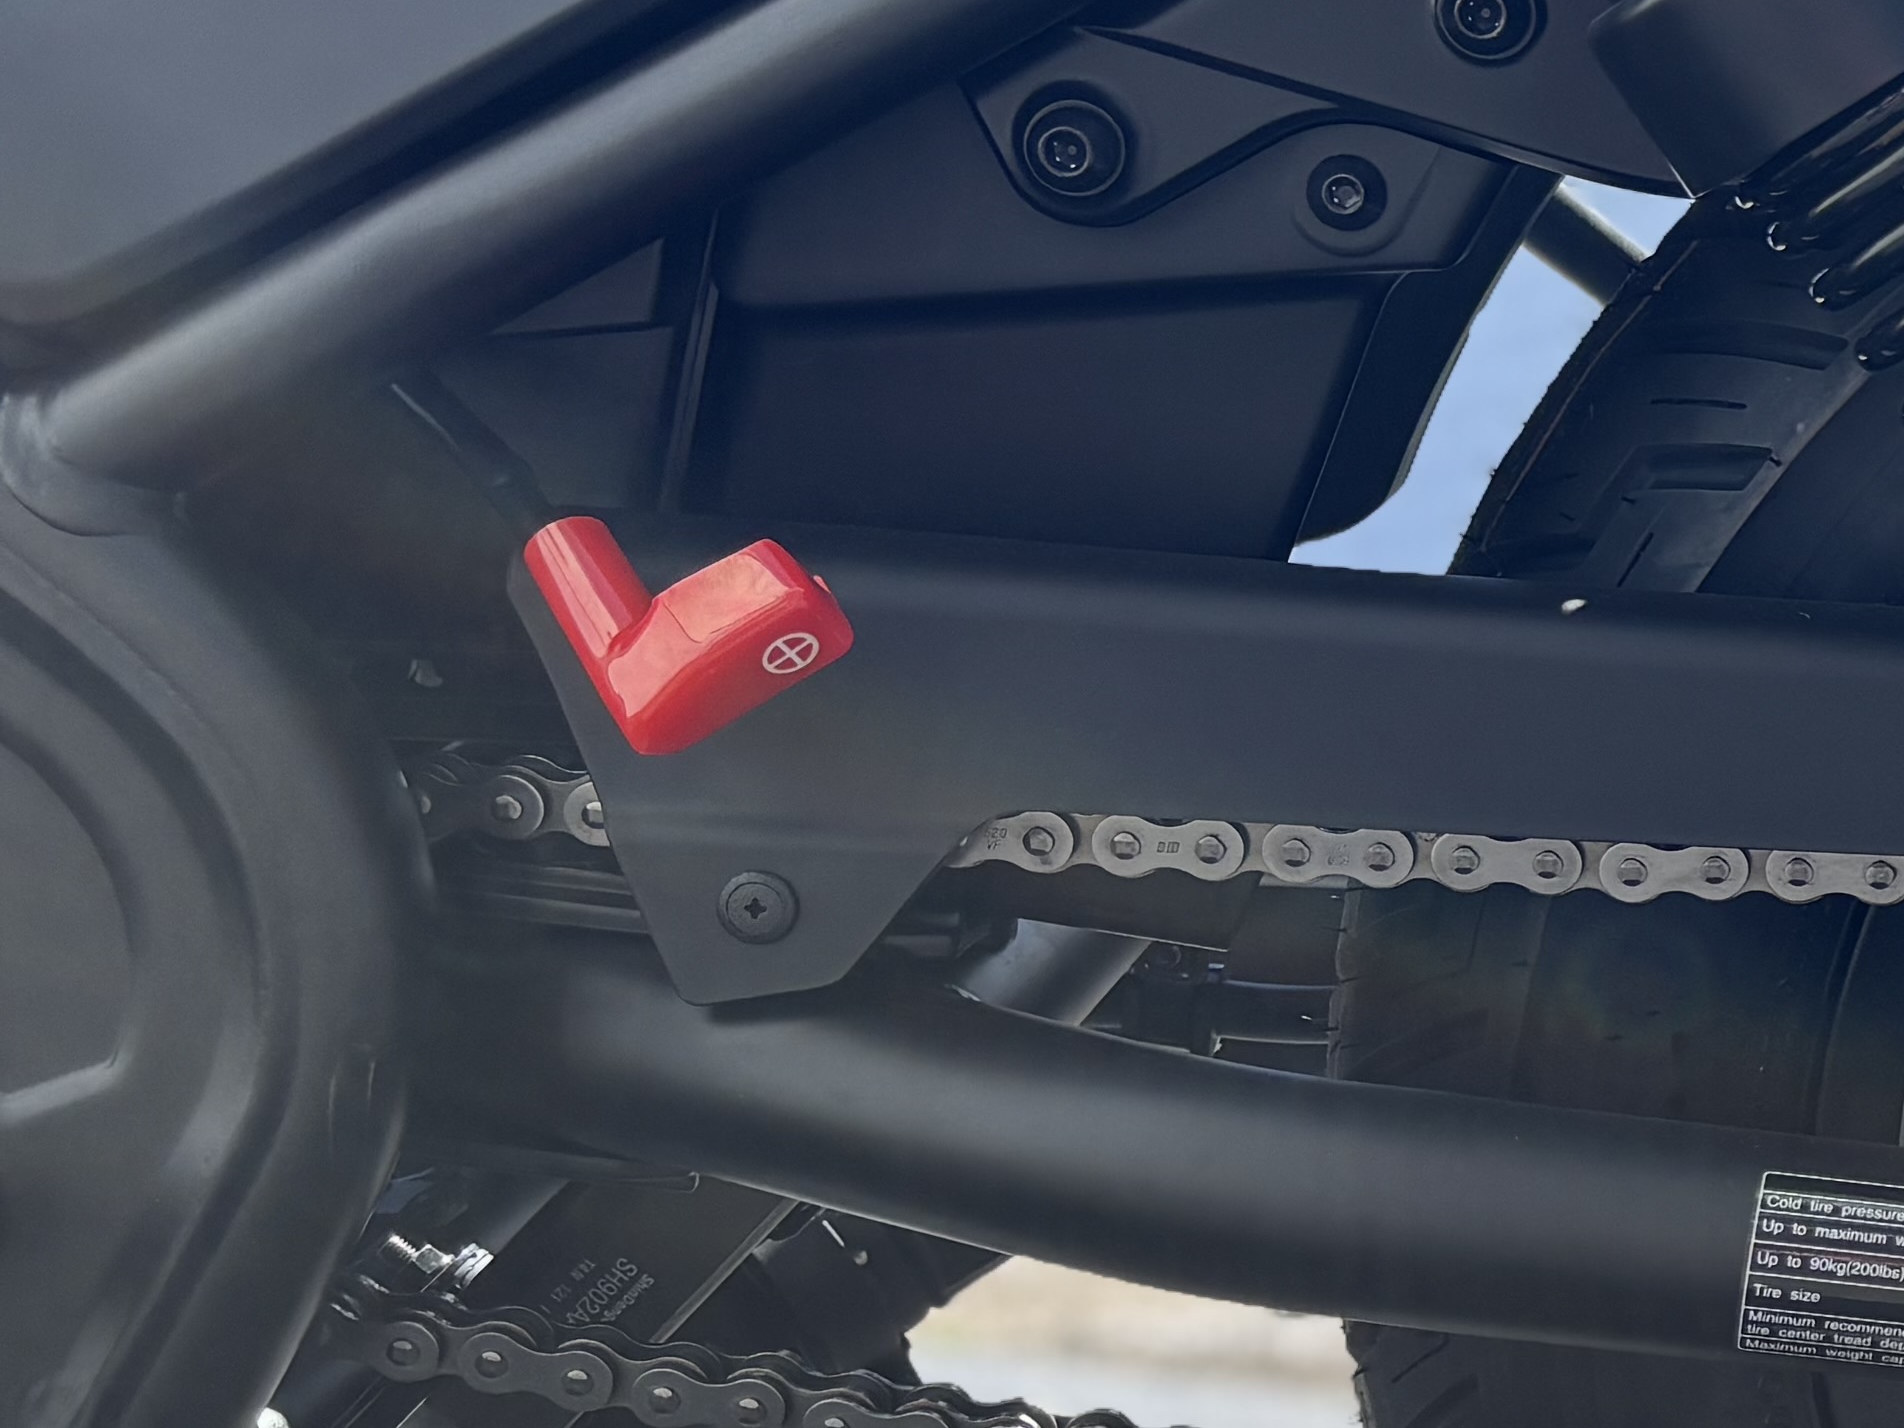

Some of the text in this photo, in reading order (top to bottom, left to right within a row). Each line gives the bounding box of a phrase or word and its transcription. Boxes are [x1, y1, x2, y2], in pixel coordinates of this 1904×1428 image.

[1767, 1196, 1801, 1210] Cold
[1810, 1200, 1832, 1213] tire
[1762, 1219, 1784, 1235] Up
[1792, 1223, 1806, 1234] to
[1815, 1227, 1887, 1245] maximum
[1757, 1251, 1778, 1266] Up
[1787, 1255, 1801, 1268] to
[600, 1273, 655, 1322] ShinDeng
[1753, 1284, 1820, 1302] Tire size
[1749, 1311, 1816, 1327] Minimum
[1747, 1324, 1770, 1336] tire
[1778, 1328, 1825, 1342] center
[1834, 1334, 1872, 1347] tread
[1746, 1339, 1816, 1354] Maximum
[1826, 1348, 1873, 1362] weight
